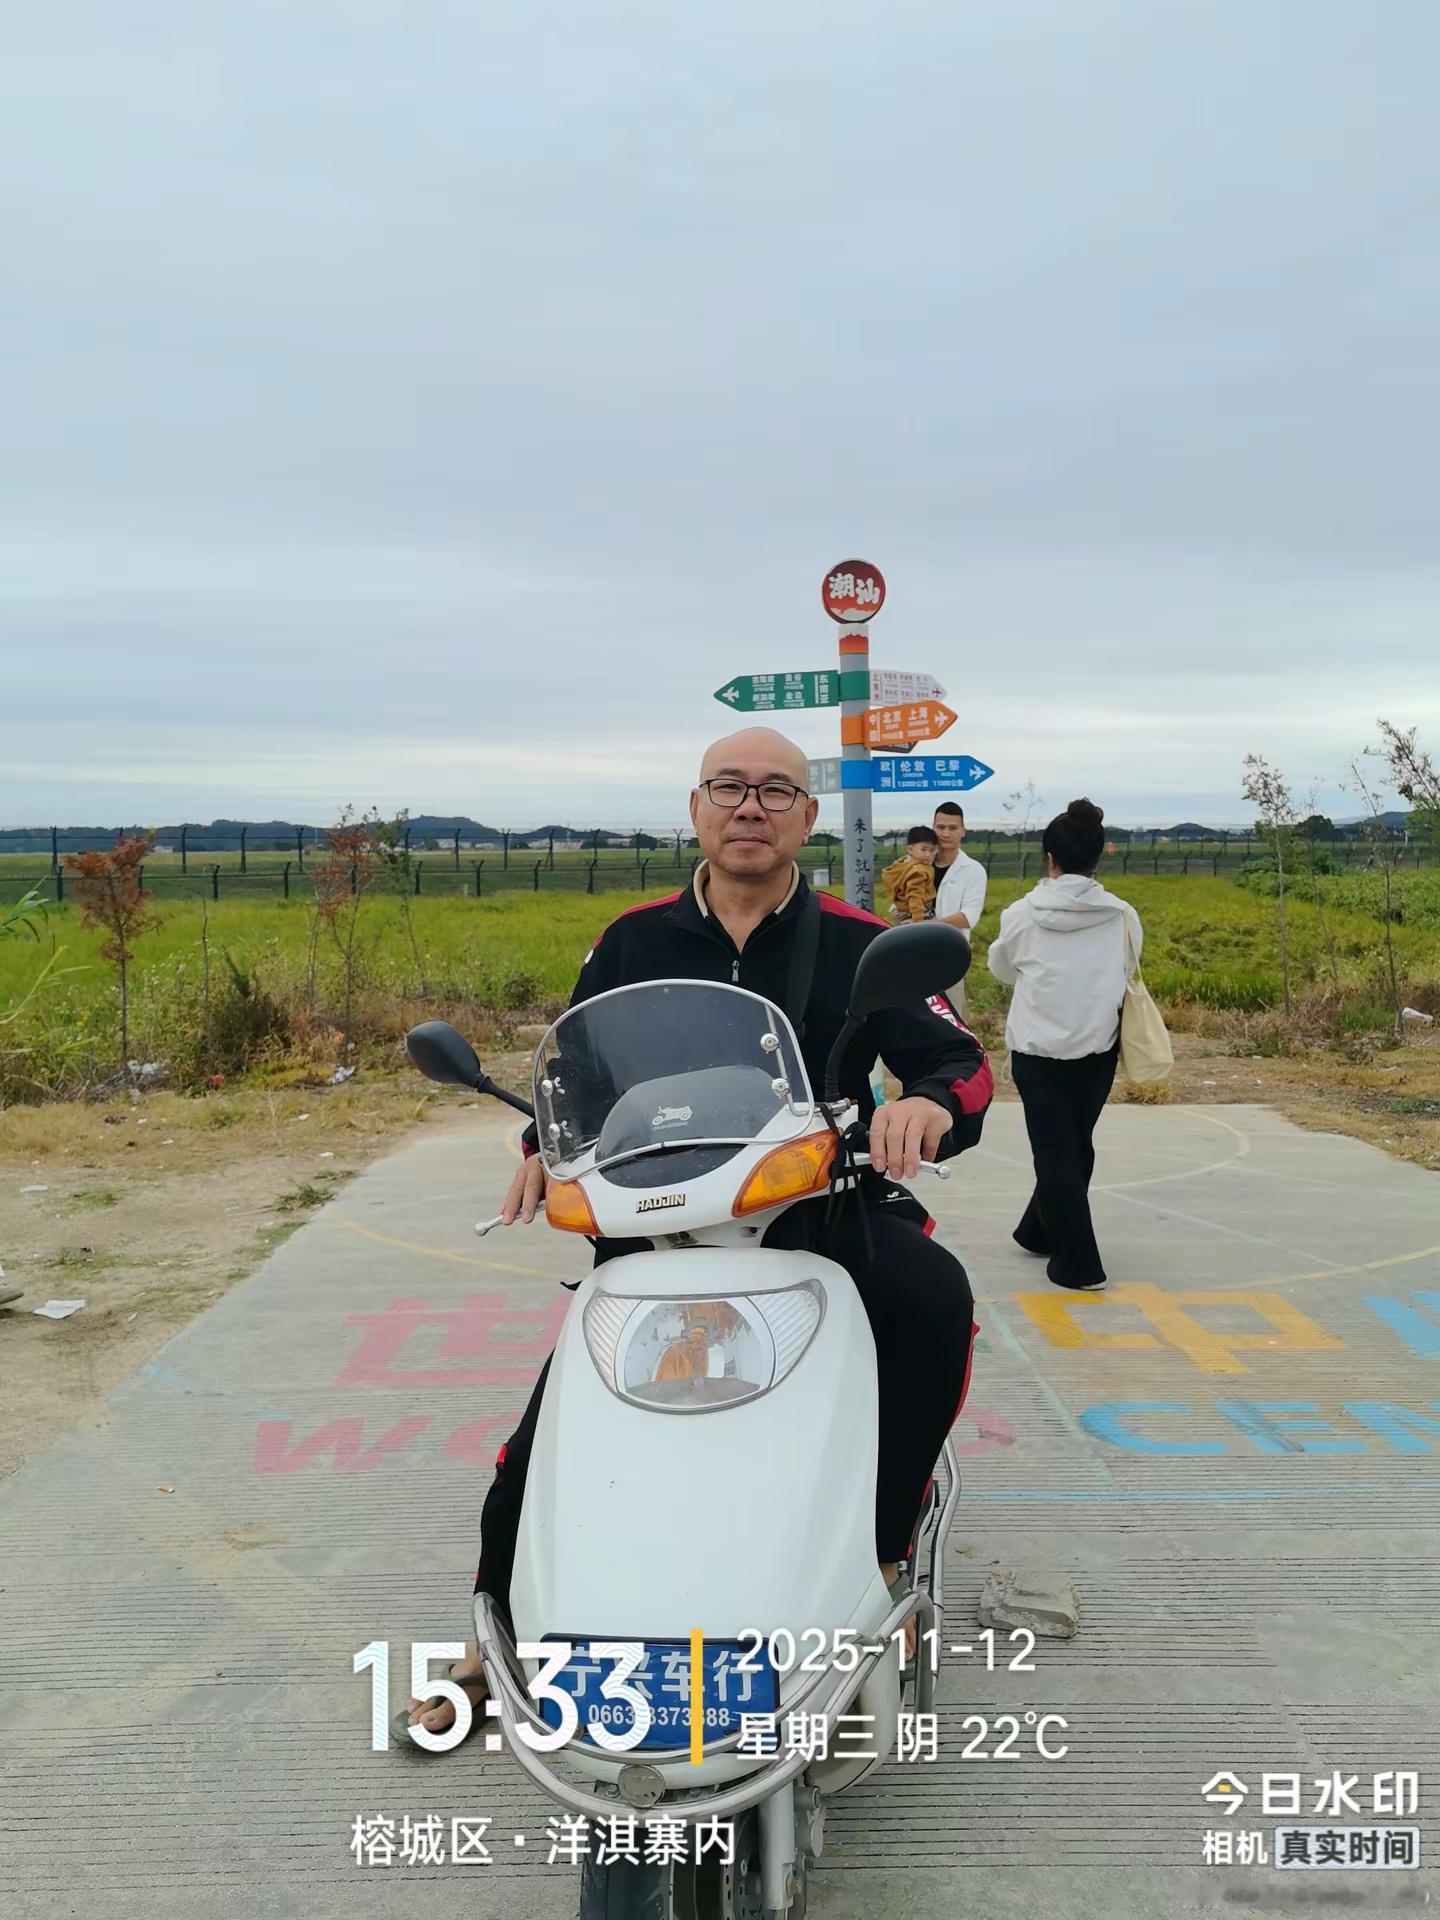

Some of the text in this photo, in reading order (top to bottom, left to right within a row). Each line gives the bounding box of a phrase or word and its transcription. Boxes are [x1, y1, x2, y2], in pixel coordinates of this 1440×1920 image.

[828, 572, 881, 605] 潮汕
[900, 759, 960, 773] 伦敦 巴黎
[1013, 1281, 1350, 1374] 中
